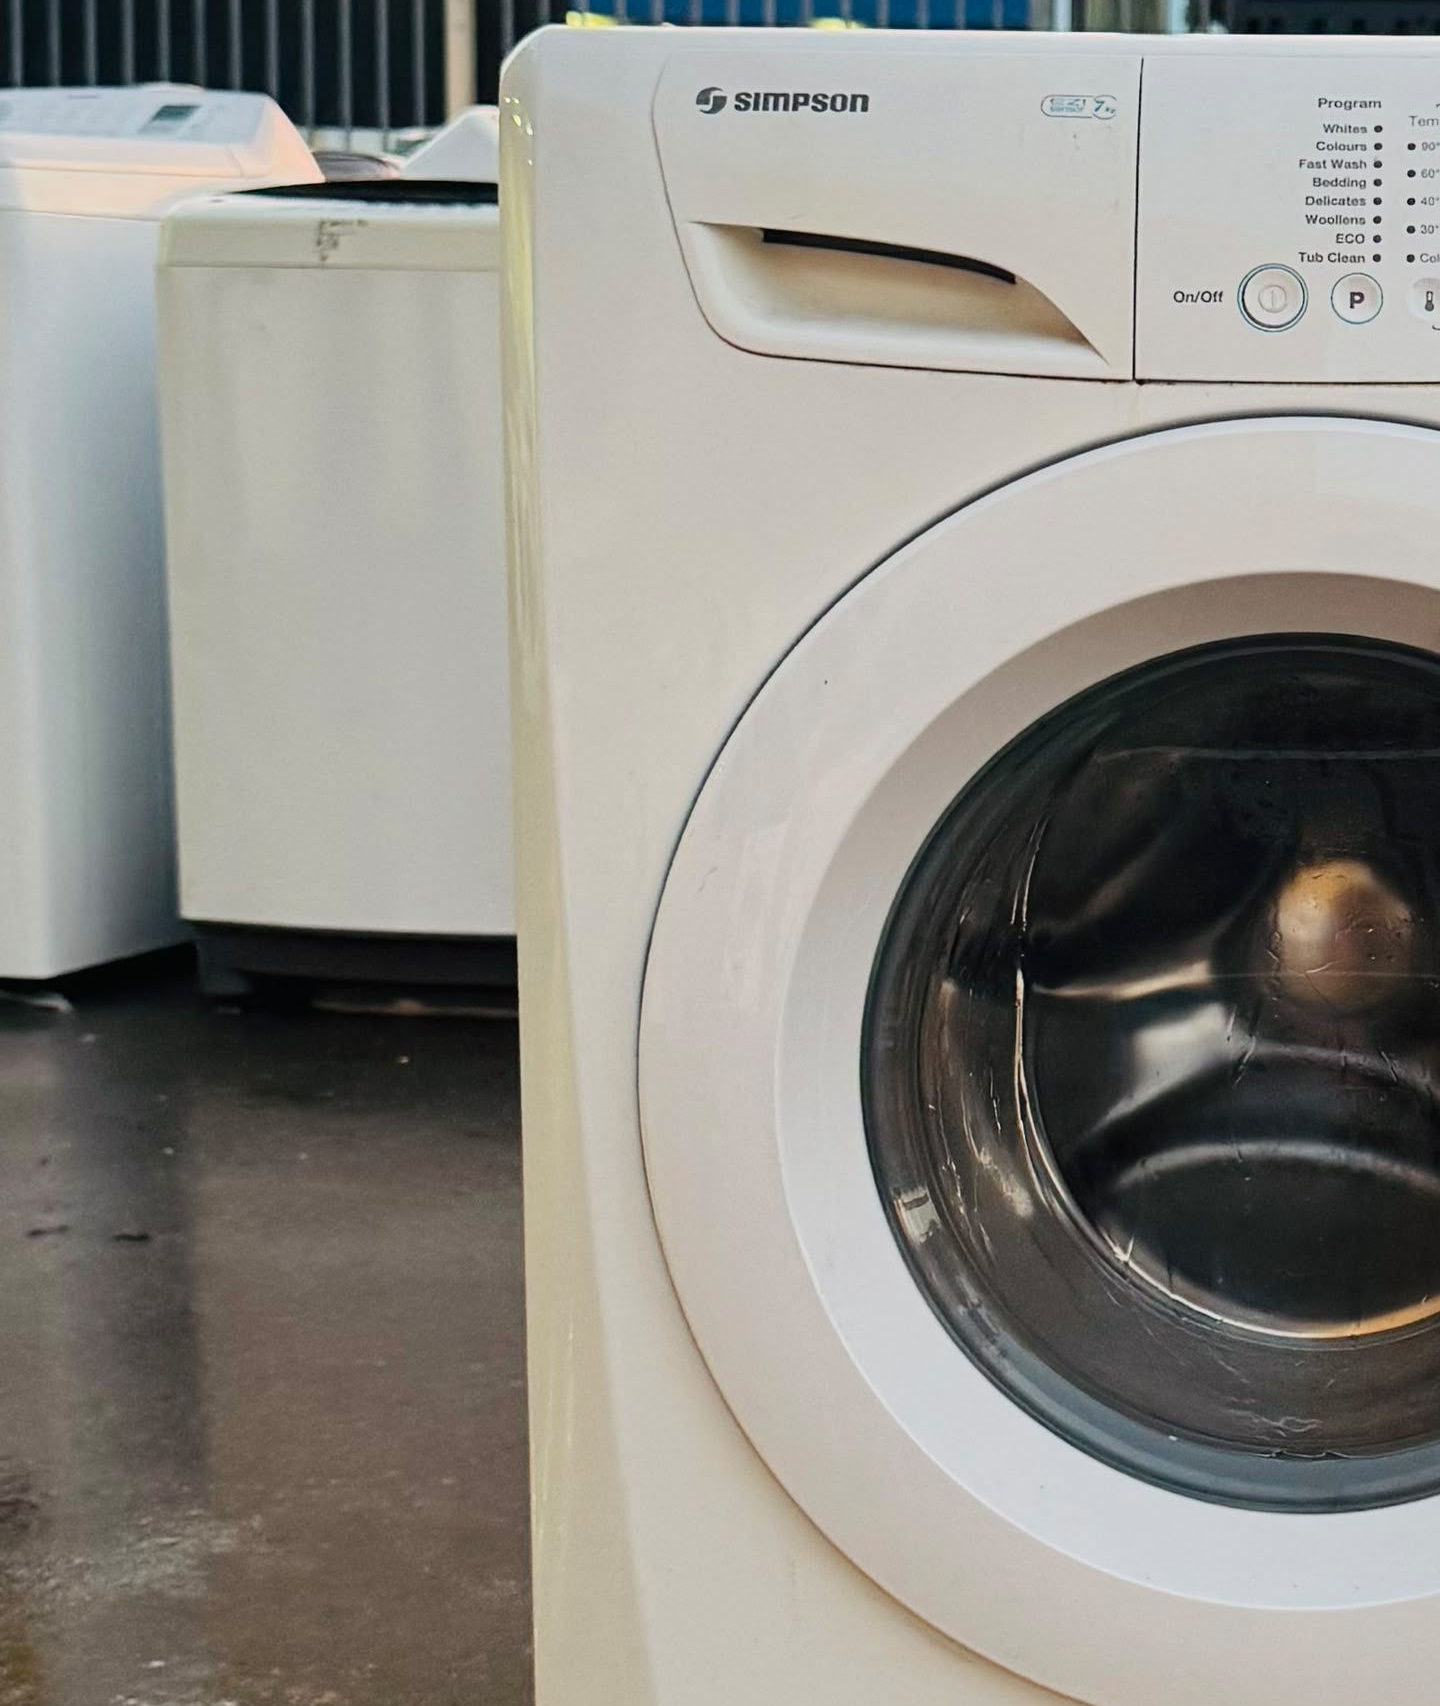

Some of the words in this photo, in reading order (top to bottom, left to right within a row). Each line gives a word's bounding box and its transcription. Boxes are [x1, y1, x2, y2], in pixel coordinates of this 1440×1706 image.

[734, 92, 870, 113] SIMPSON
[1317, 97, 1382, 111] Program
[1323, 123, 1368, 134] Whites
[1316, 141, 1367, 152] Colours
[1299, 159, 1327, 169] Fast
[1331, 159, 1367, 169] Wash
[1312, 177, 1367, 190] Bedding
[1305, 196, 1366, 206] Delicates
[1305, 214, 1366, 225] Woollens
[1335, 233, 1366, 244] ECO
[1298, 252, 1324, 263] Tub
[1327, 252, 1366, 263] Clean
[1173, 290, 1224, 304] On/Off
[1349, 291, 1365, 309] P
